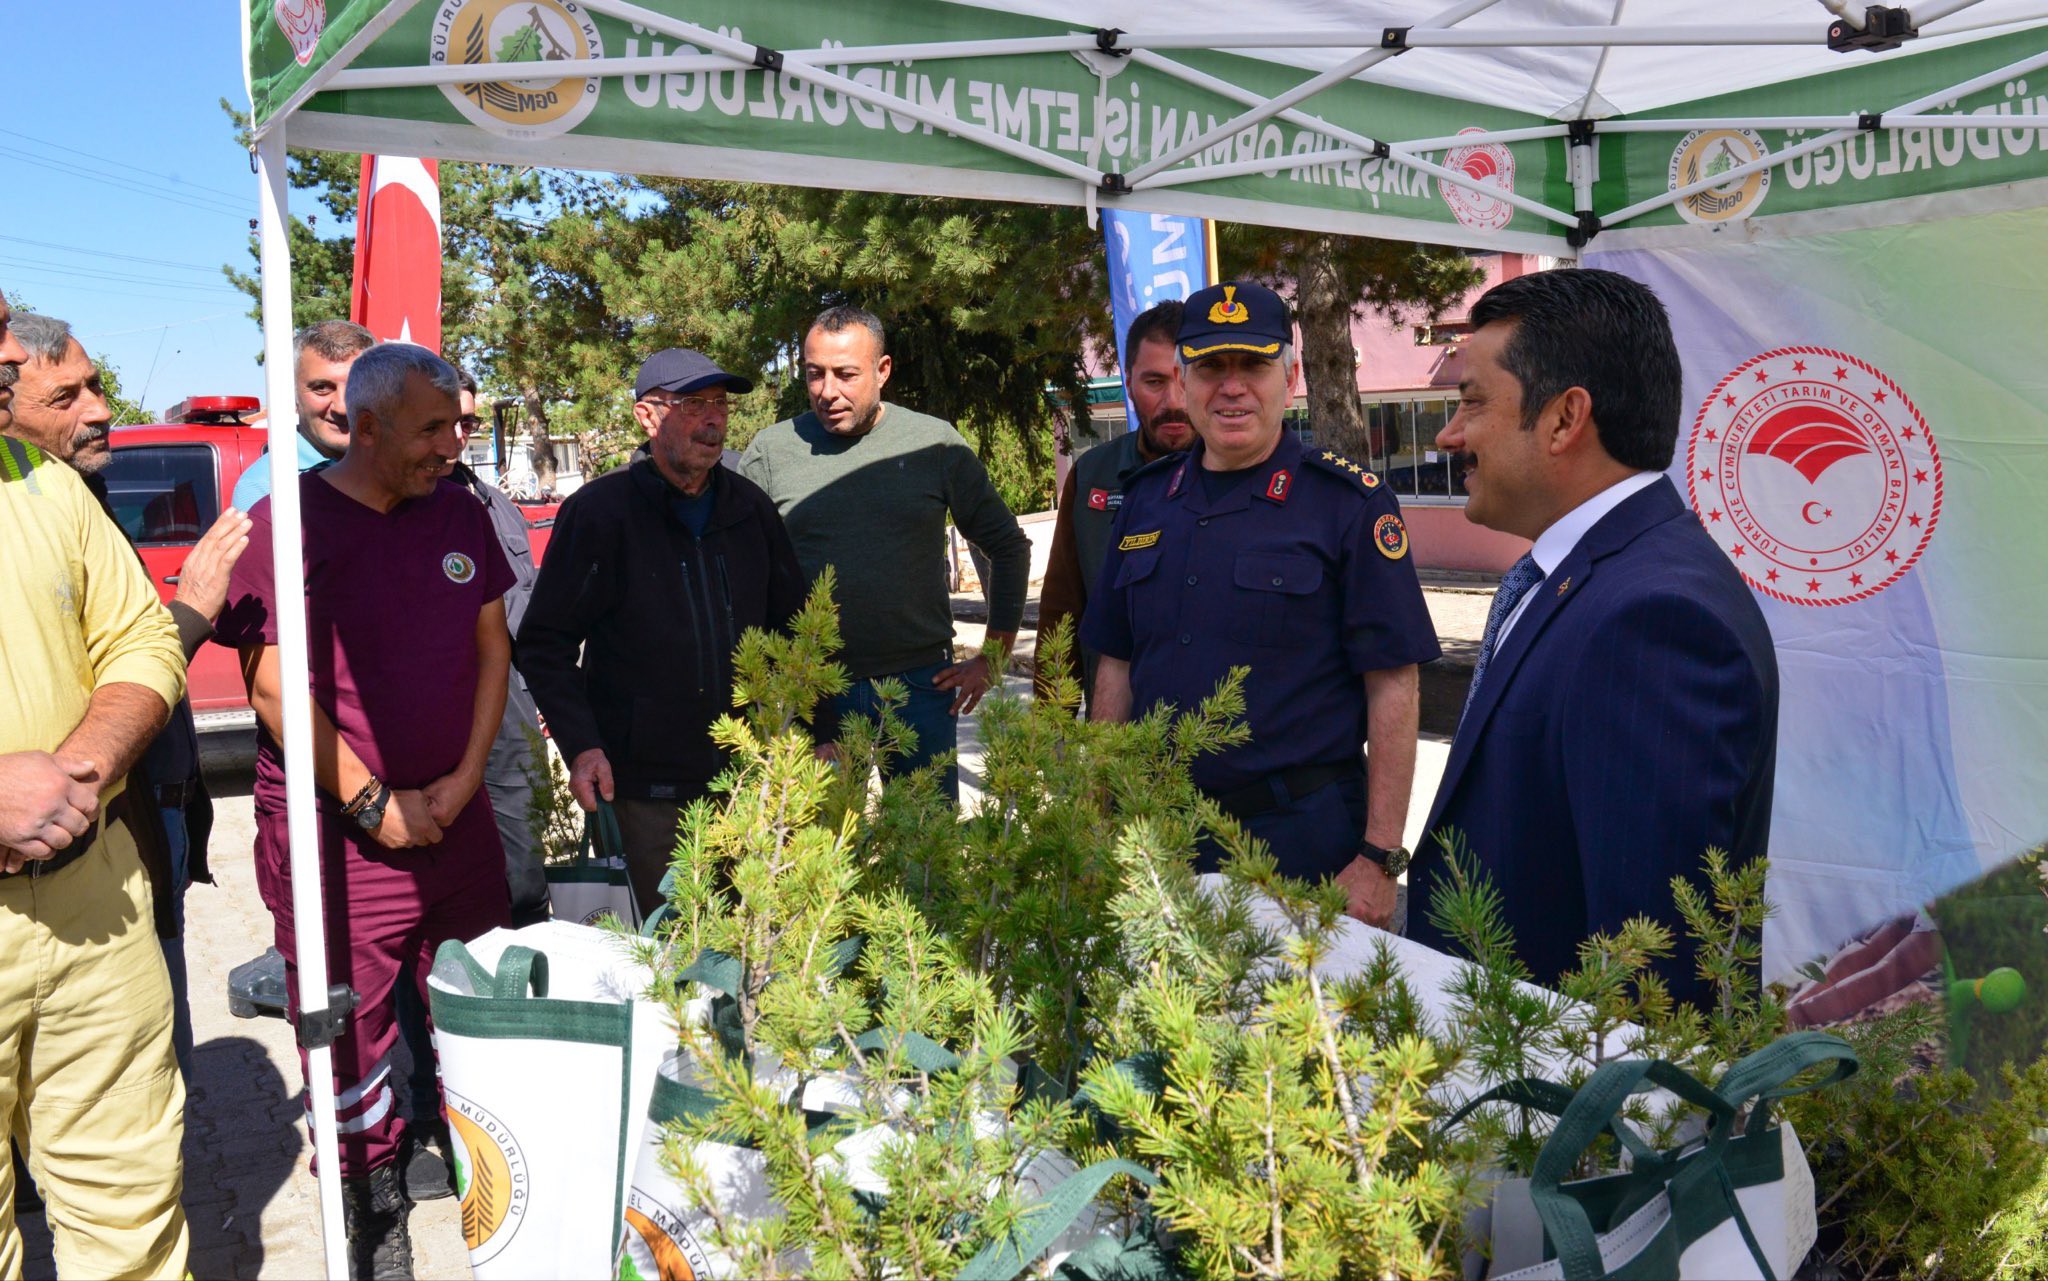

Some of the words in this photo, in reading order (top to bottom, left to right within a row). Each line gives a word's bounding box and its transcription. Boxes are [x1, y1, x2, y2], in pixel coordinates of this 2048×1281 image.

[1781, 386, 1831, 400] TARIM
[1839, 395, 1858, 412] VE
[1725, 392, 1777, 489] CUMHURİYETİ
[1863, 413, 1900, 469] ORMAN
[1730, 498, 1778, 556] TÜRKİYE
[1848, 479, 1902, 559] BAKANLIĞI
[460, 1103, 526, 1216] MÜDÜRLÜĞÜ
